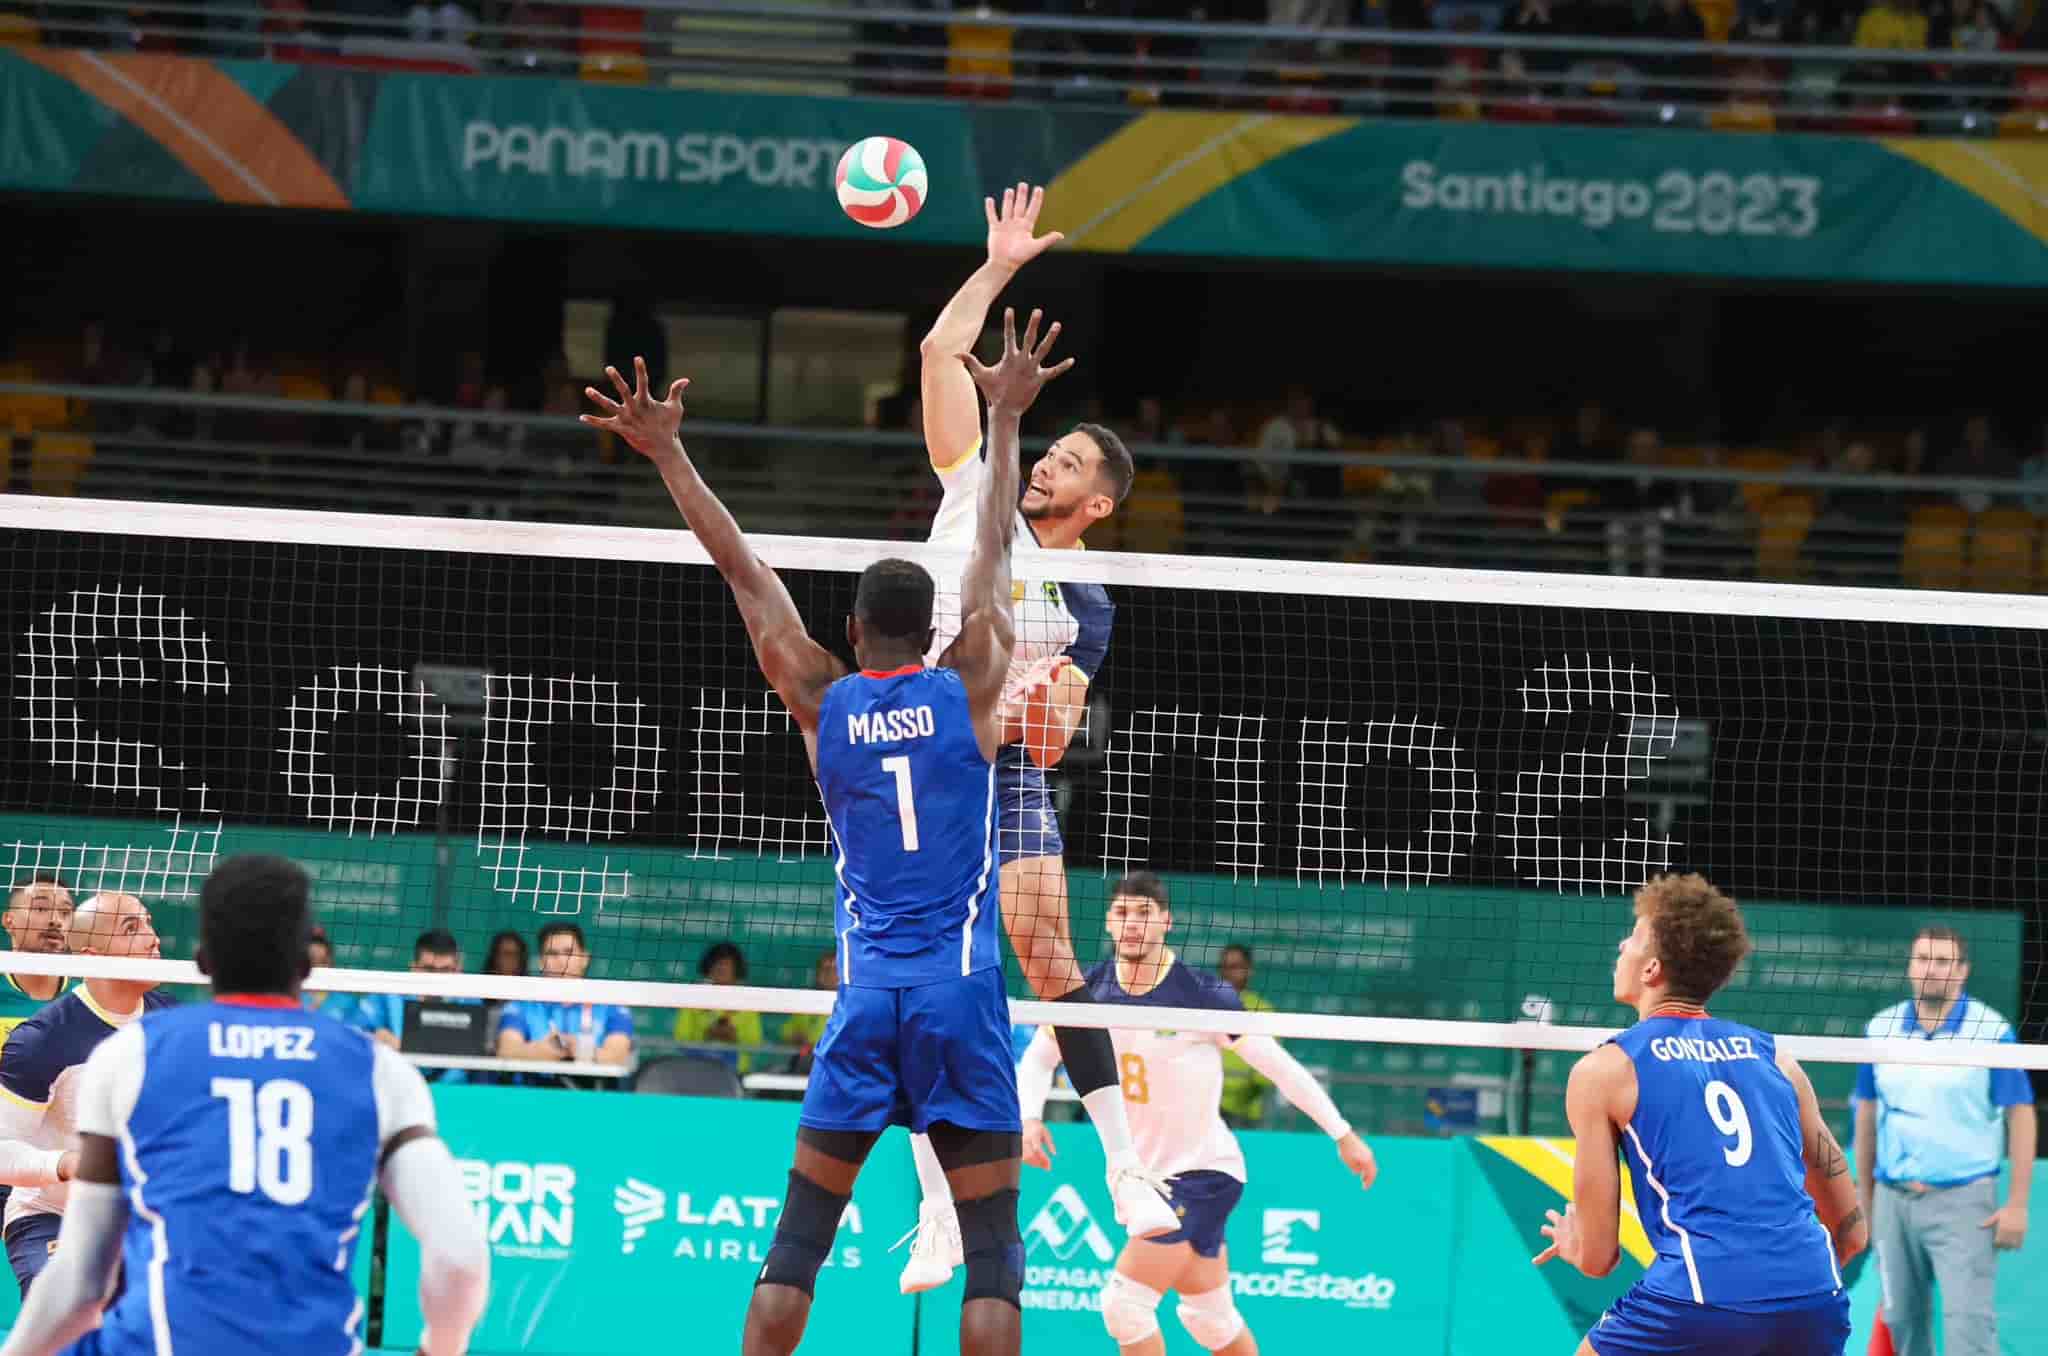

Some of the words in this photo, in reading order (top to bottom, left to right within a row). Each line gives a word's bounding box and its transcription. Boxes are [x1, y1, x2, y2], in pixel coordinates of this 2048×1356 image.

[464, 122, 668, 181] PANAM
[675, 131, 842, 190] SPORT
[1402, 160, 1652, 230] Santiago
[1652, 168, 1821, 237] 2023
[848, 705, 935, 745] MASSO
[881, 755, 919, 852] 1
[209, 1020, 318, 1061] LOPEZ
[1650, 1036, 1760, 1062] GONZALEZ
[211, 1077, 314, 1206] 18
[1704, 1079, 1753, 1167] 9
[676, 1191, 863, 1234] LAT
[673, 1236, 862, 1269] AIRLS
[1229, 1268, 1396, 1300] ncoEstado
